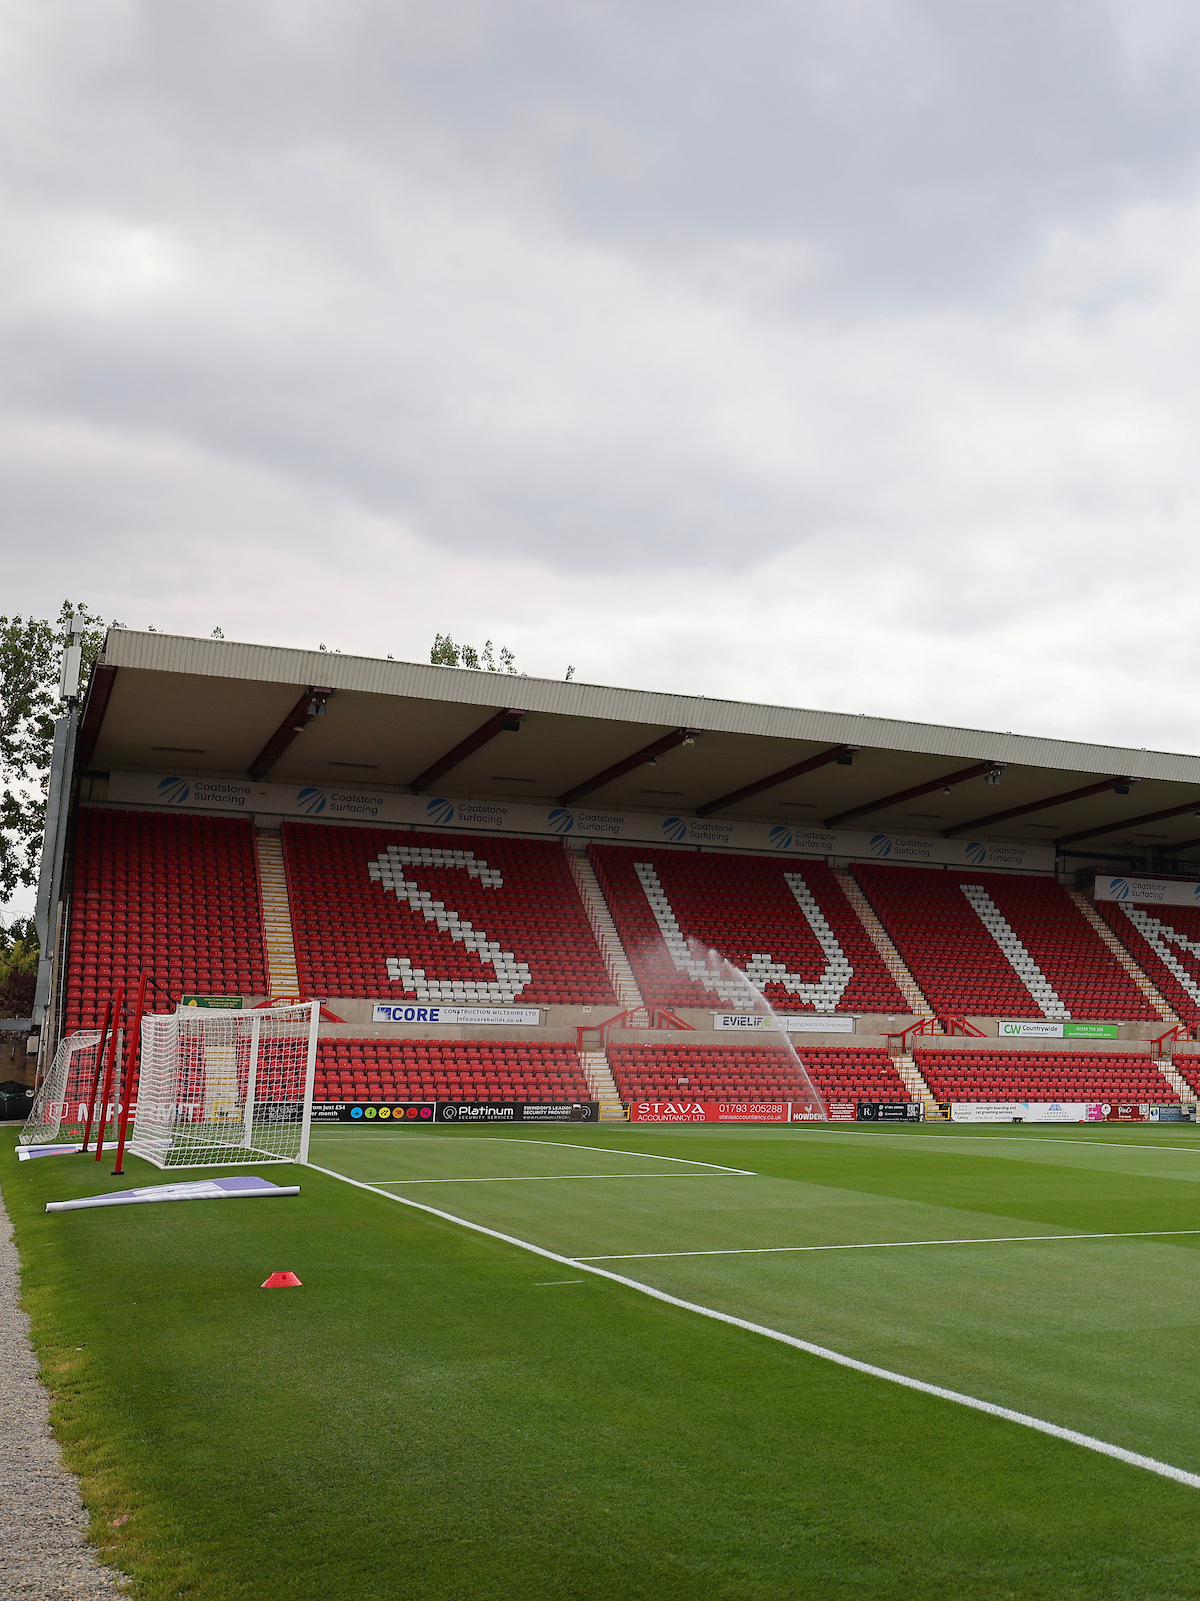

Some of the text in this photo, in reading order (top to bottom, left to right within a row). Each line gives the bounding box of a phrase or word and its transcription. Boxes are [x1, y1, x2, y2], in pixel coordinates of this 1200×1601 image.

[196, 782, 250, 794] Coatstone
[194, 792, 245, 806] Surfacing
[332, 793, 383, 804] Coatstone
[330, 803, 378, 816] Surfacing
[459, 804, 507, 814] Coatstone
[458, 813, 502, 825] Surfacing
[579, 813, 624, 823] Coatstone
[578, 823, 620, 834] Surfacing
[691, 822, 734, 832] Coatstone
[690, 831, 729, 842] Surfacing
[796, 831, 836, 840] Coatstone
[795, 840, 832, 850] Surfacing
[896, 839, 934, 848] Coatstone
[895, 847, 930, 857] Surfacing
[990, 847, 1025, 855] Coatstone
[989, 855, 1022, 865] Surfacing
[1132, 883, 1166, 891] Coatstone
[1132, 891, 1163, 900] Surfacing
[393, 1007, 440, 1022] CORE
[1004, 1024, 1021, 1034] CW
[459, 1106, 513, 1116] Platinum
[638, 1103, 706, 1114] STAVA
[719, 1104, 783, 1113] 01793 205288
